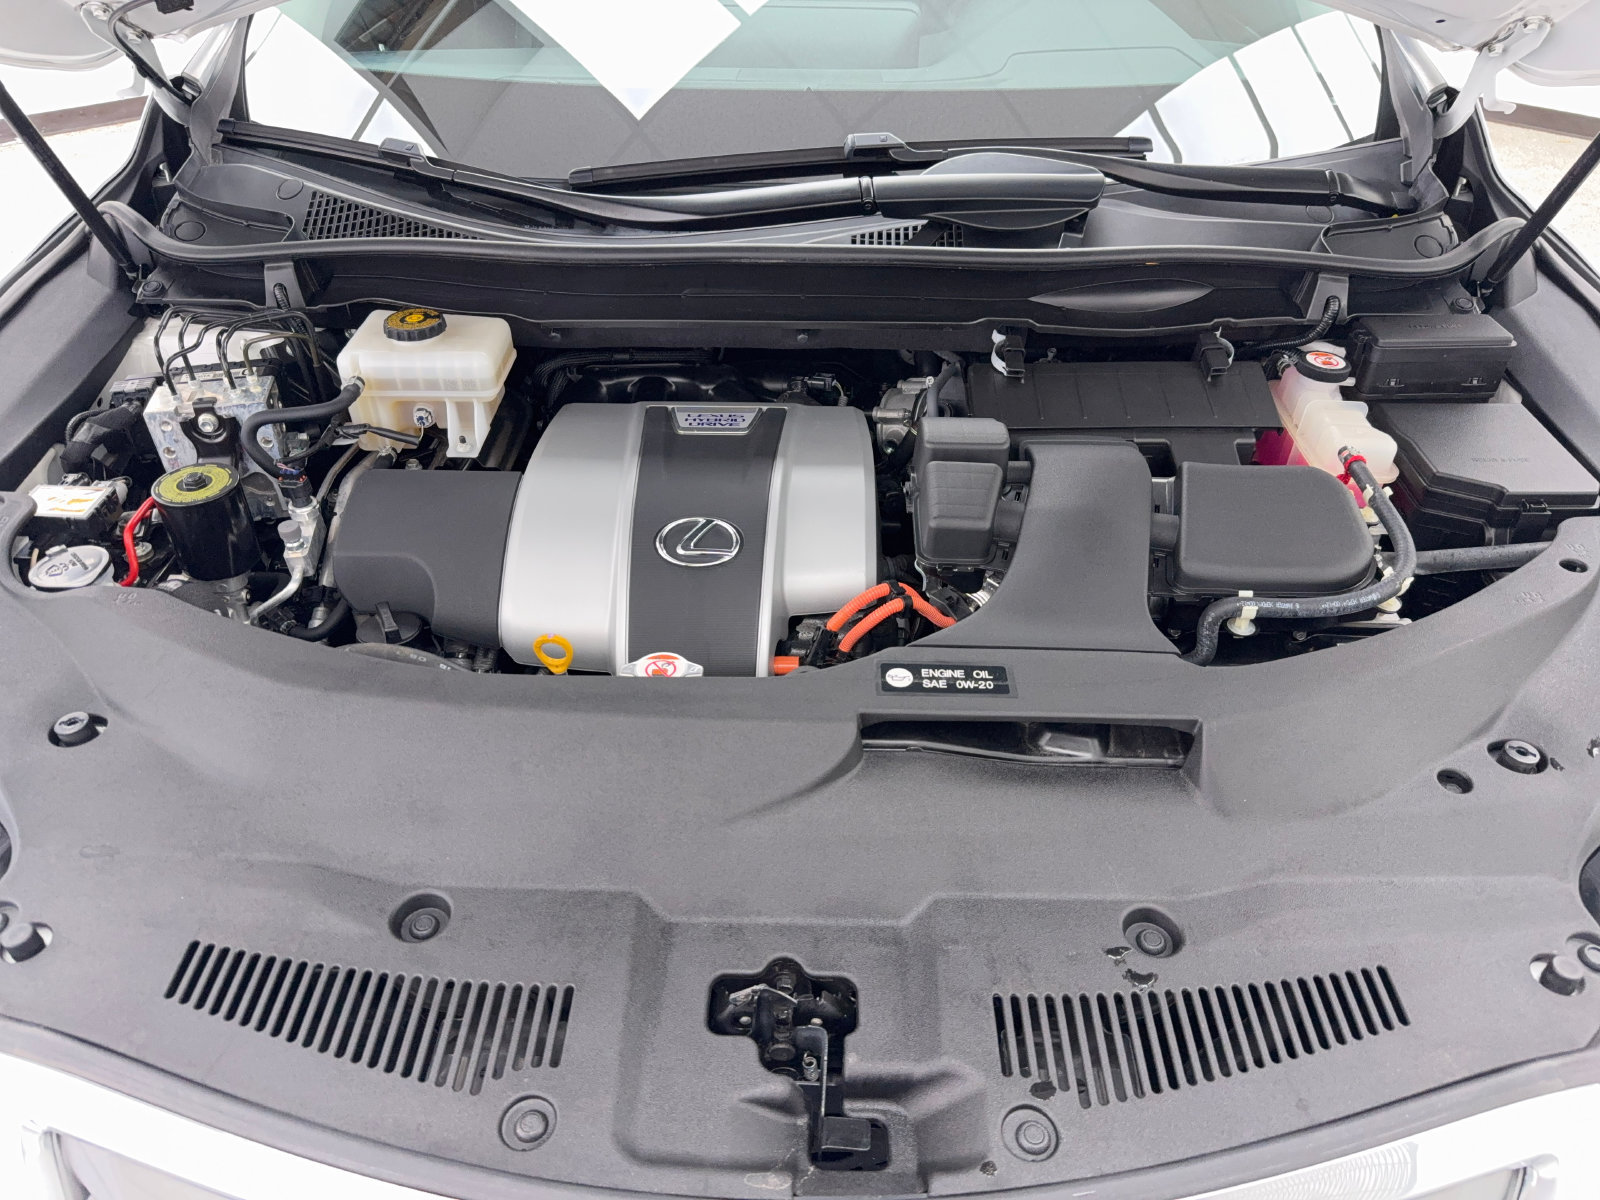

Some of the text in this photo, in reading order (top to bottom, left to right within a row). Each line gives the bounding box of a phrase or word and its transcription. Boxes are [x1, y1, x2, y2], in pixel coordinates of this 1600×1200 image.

[921, 668, 994, 680] ENGINE OIL
[922, 679, 994, 690] SAE 0W-20
